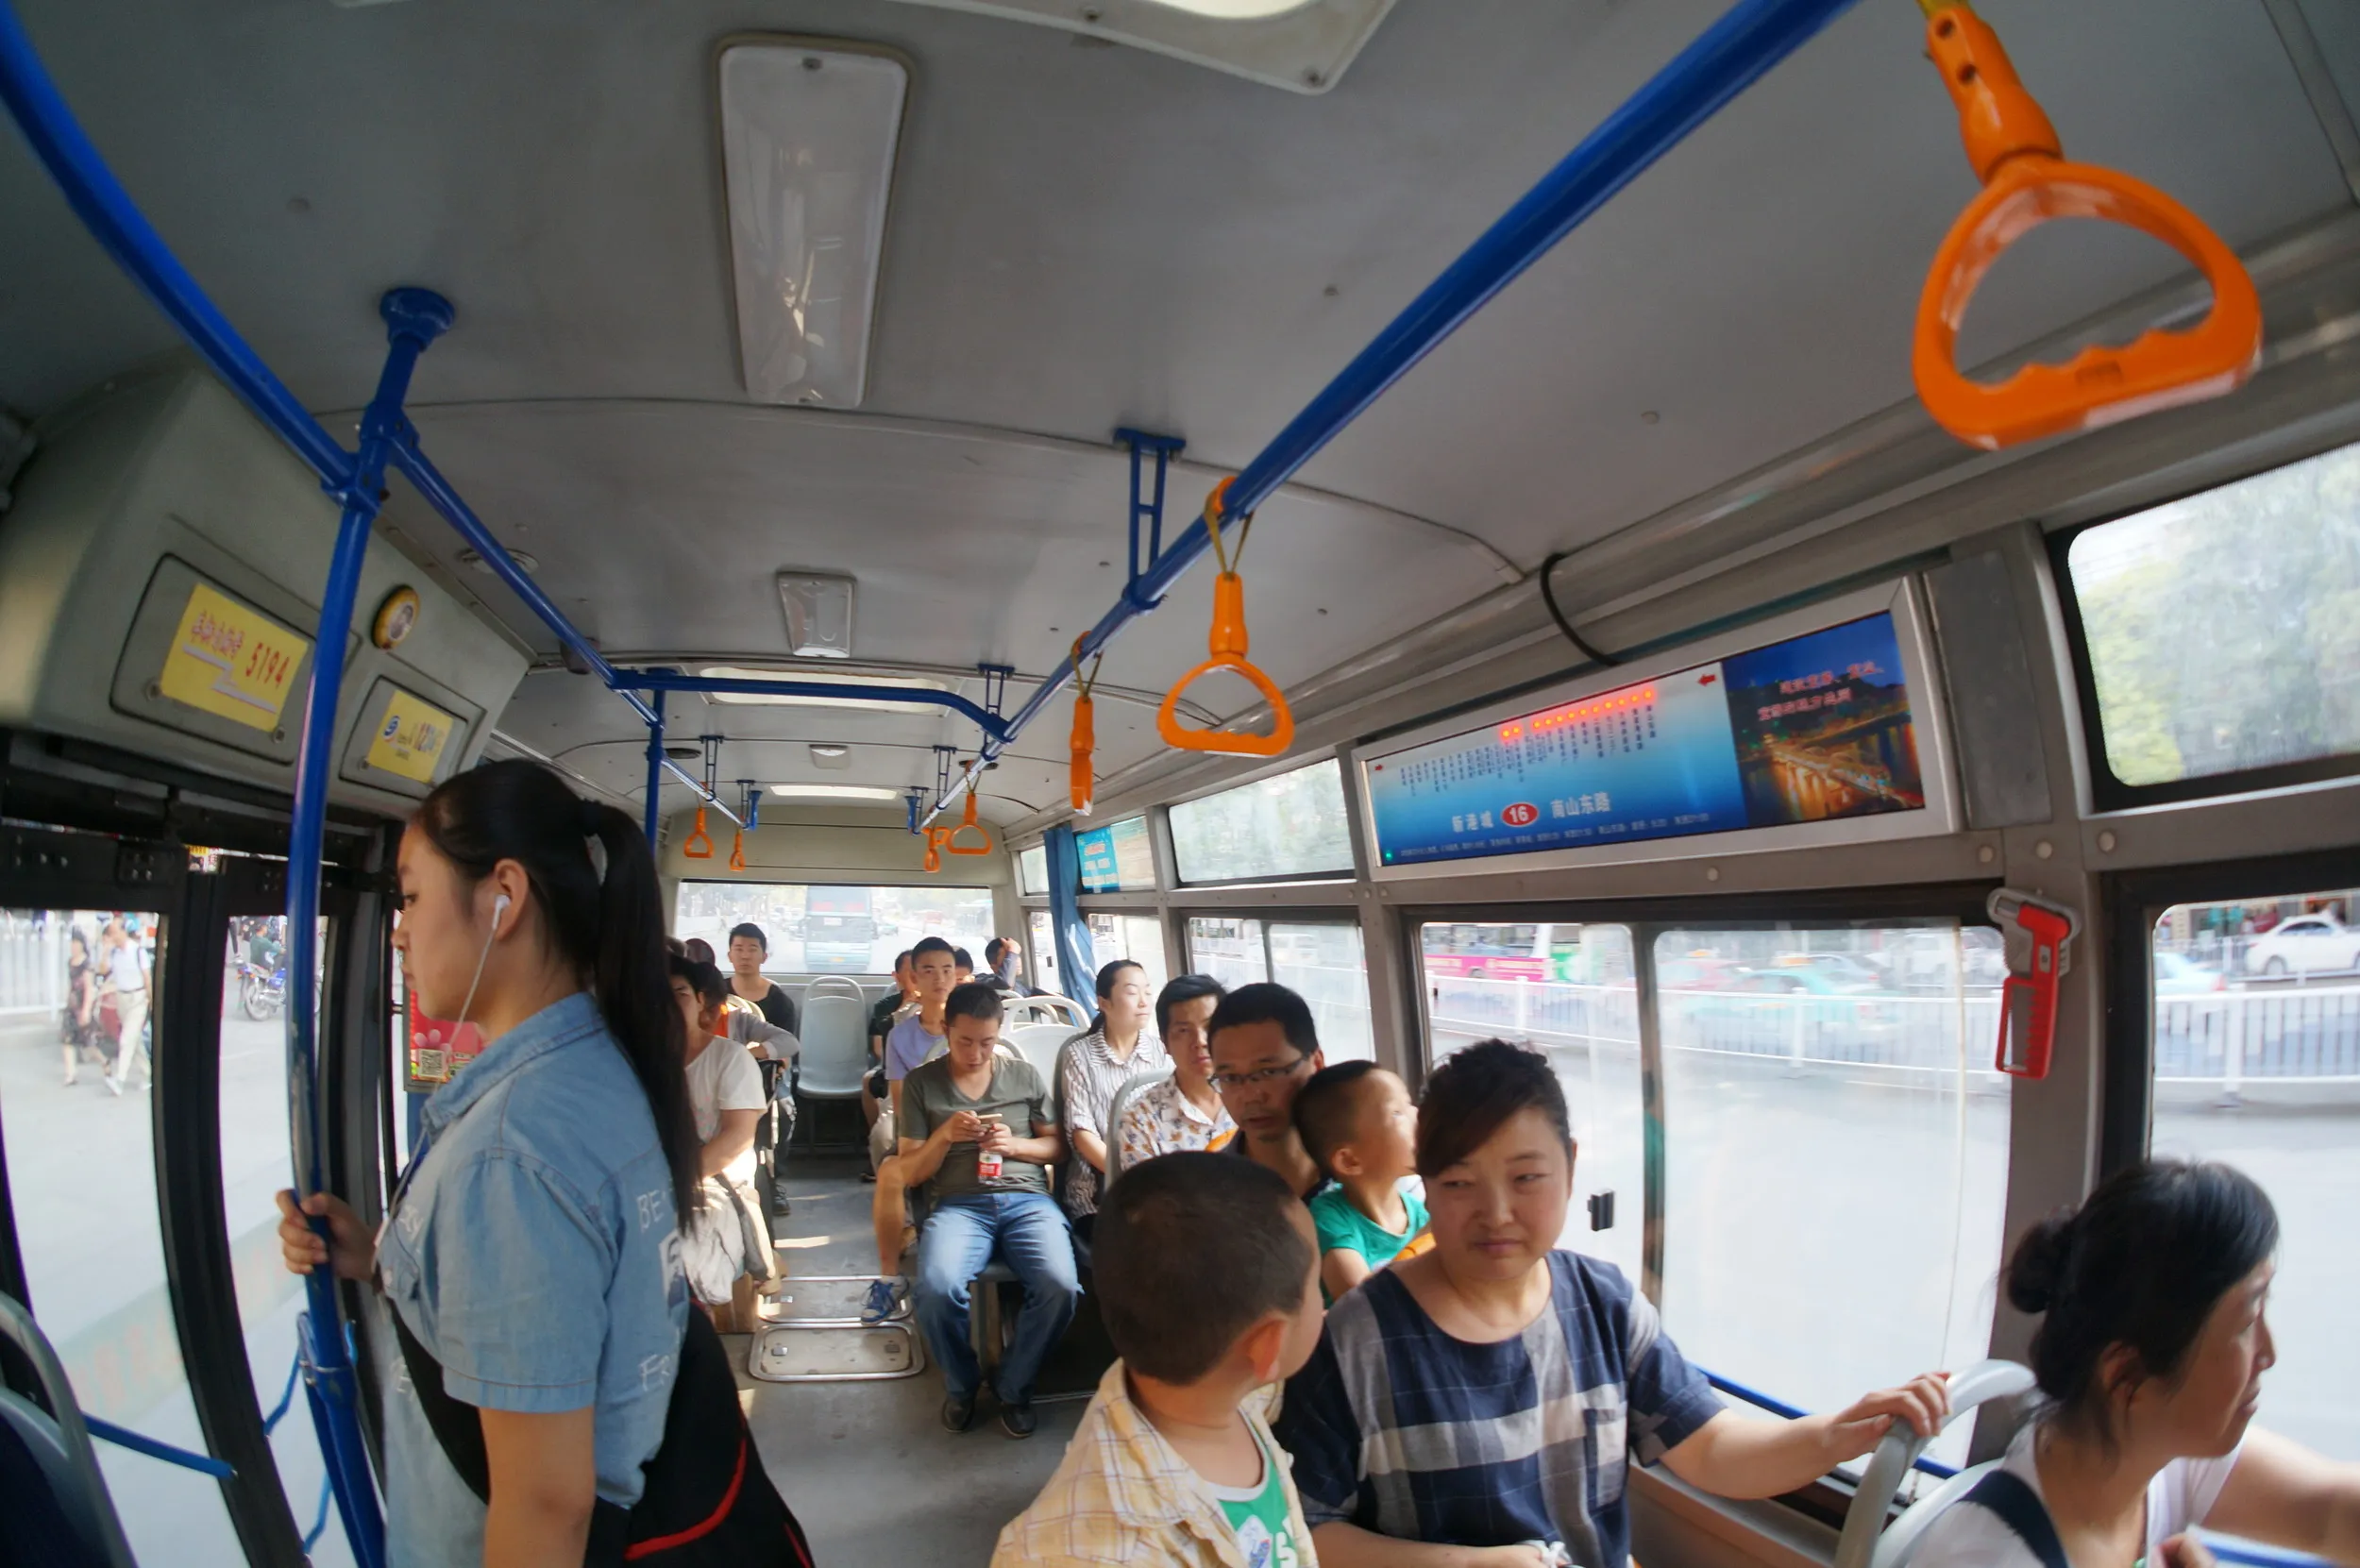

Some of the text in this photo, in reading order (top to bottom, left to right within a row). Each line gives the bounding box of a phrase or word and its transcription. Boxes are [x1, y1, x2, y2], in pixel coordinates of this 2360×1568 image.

[1509, 805, 1530, 823] 16
[1551, 792, 1611, 818] 南山东路
